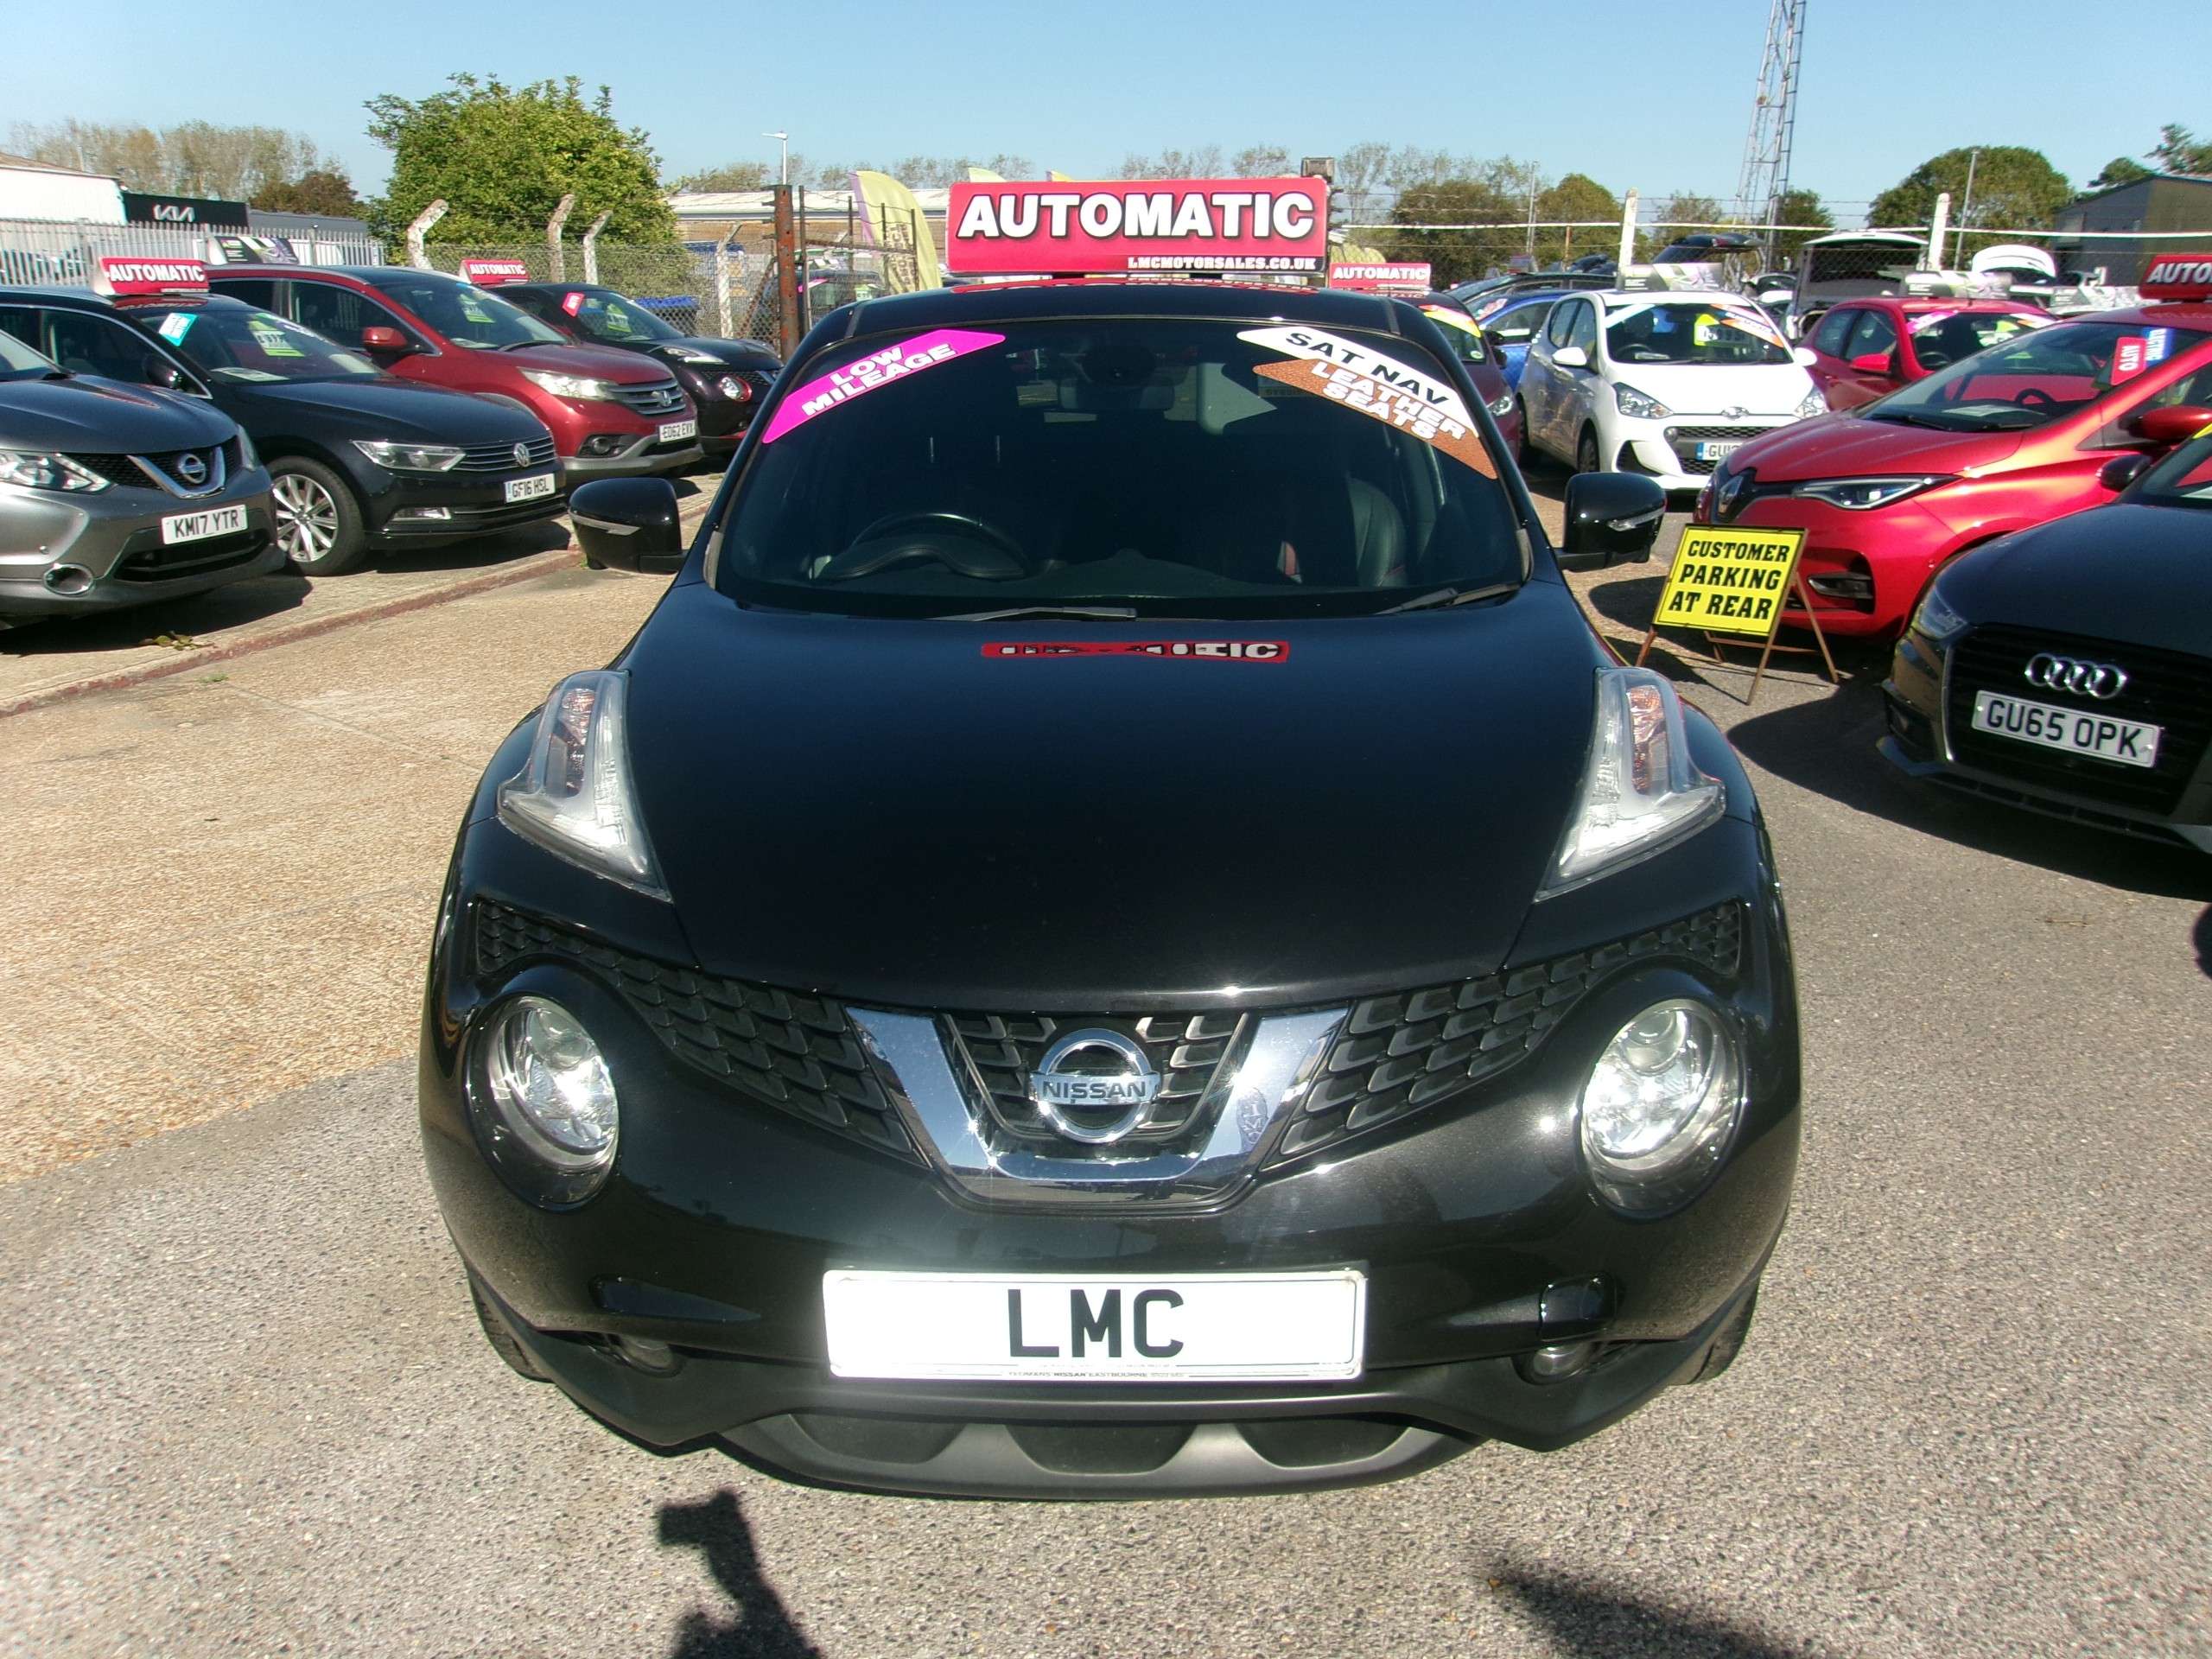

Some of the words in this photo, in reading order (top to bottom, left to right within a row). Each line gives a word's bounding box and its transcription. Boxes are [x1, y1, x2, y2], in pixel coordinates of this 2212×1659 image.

[956, 192, 1314, 239] AUTOMATIC
[109, 264, 205, 282] AUTOMATIC
[469, 264, 525, 275] AUTOMATIC
[1128, 257, 1315, 270] LMCMOTORSALES.CO.UK
[1333, 267, 1427, 280] AUTOMATIC
[2146, 262, 2212, 283] AUTO
[830, 346, 903, 386] LOW
[1286, 333, 1365, 364] SAT
[1370, 364, 1449, 405] NAV
[2118, 345, 2140, 372] AUTO
[801, 343, 957, 416] MILEAGE
[1311, 361, 1466, 440] LEATHER
[1322, 382, 1439, 440] SEATS
[512, 480, 532, 498] GF16
[533, 477, 550, 494] HSL
[174, 514, 208, 538] KM17
[213, 510, 238, 531] YTR
[1688, 540, 1790, 562] CUSTOMER
[1679, 563, 1782, 590] PARKING
[1668, 591, 1701, 612] AT
[1705, 594, 1772, 620] REAR
[1987, 700, 2065, 741] GU65
[2075, 718, 2141, 758] OPK
[1042, 1081, 1147, 1099] NISSAN
[1007, 1288, 1185, 1358] LMC
